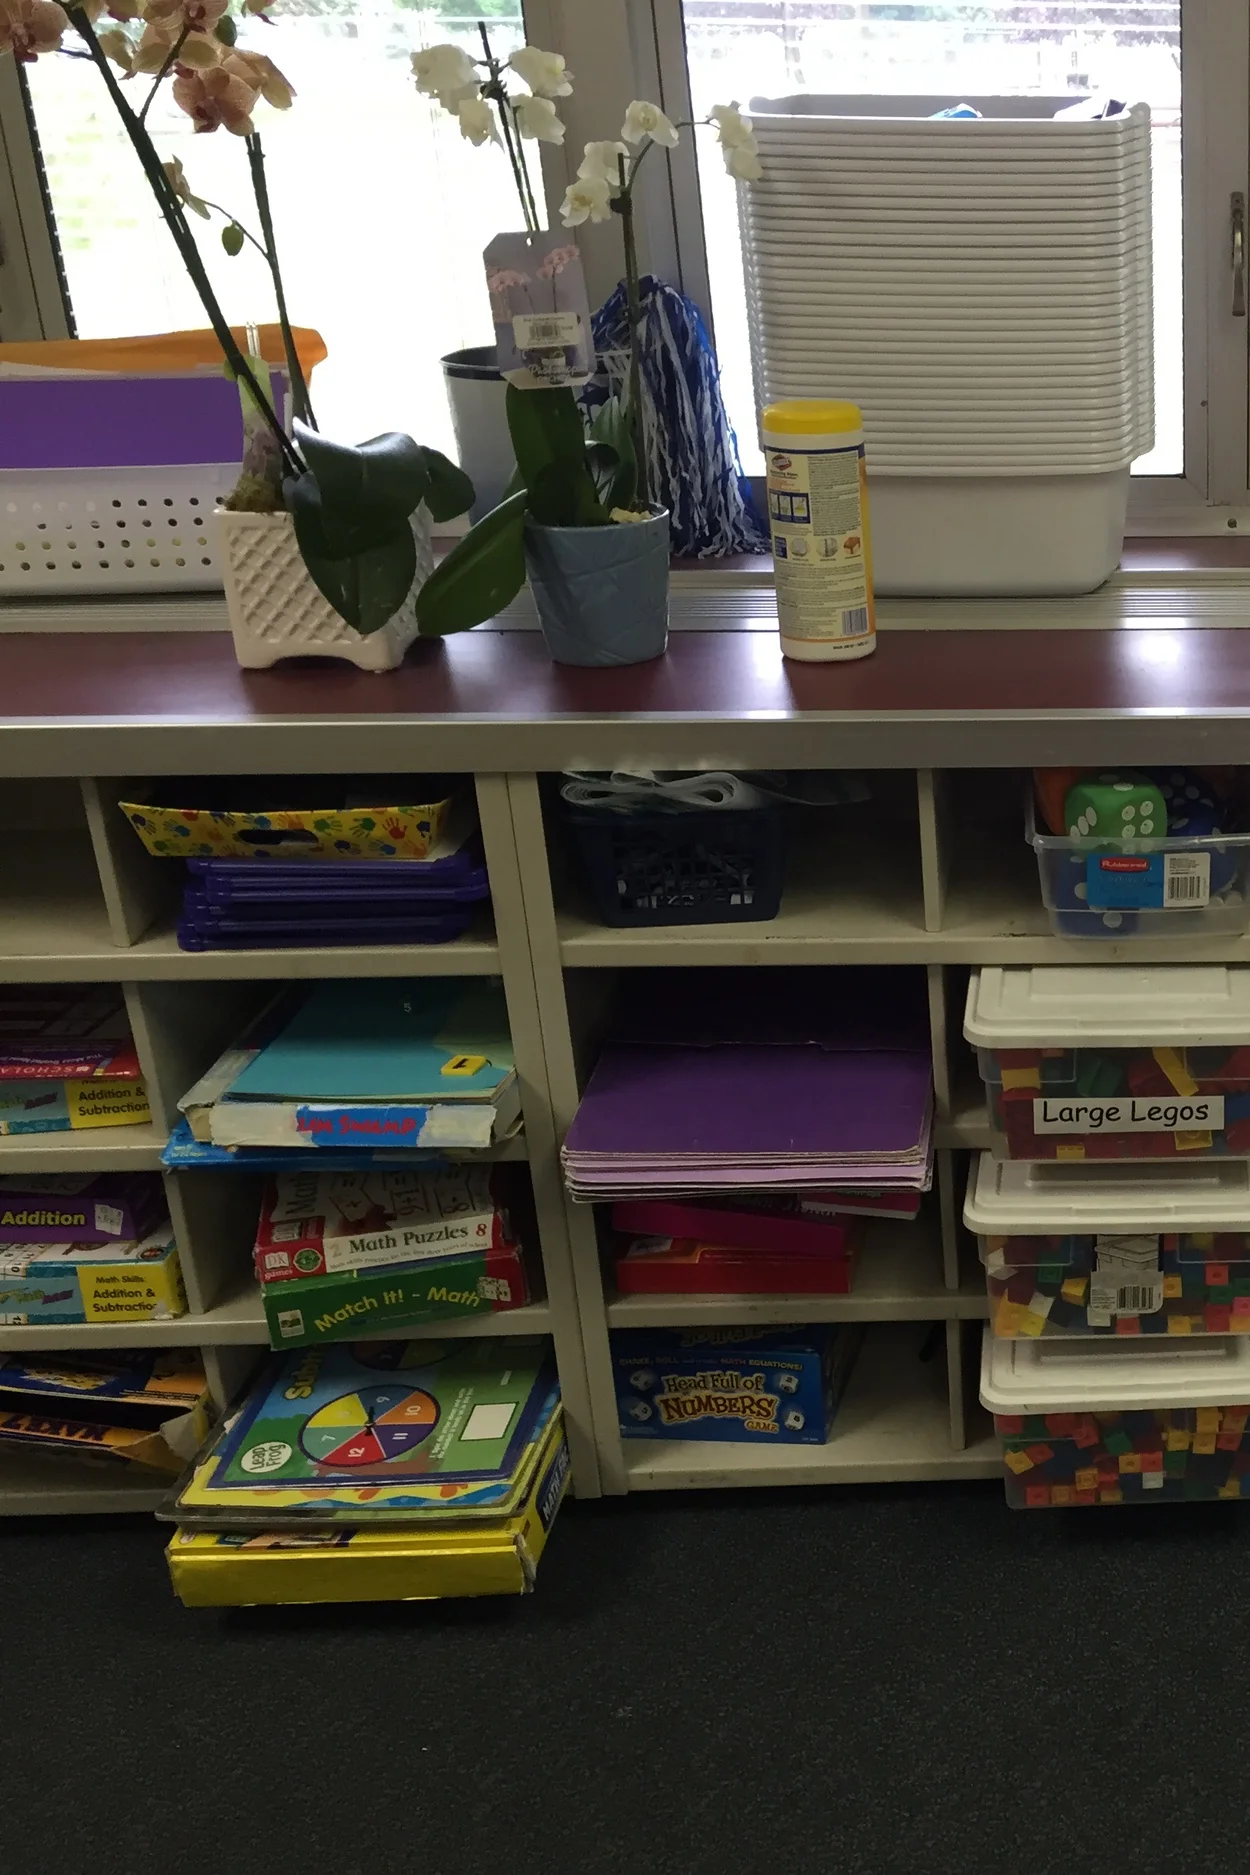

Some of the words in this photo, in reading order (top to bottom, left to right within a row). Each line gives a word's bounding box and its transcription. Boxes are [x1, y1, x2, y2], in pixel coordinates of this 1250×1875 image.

[79, 1087, 131, 1102] Addition
[136, 1086, 146, 1097] &
[79, 1102, 150, 1116] Subtraction
[1043, 1101, 1121, 1127] Large
[1131, 1100, 1209, 1127] Legos
[1, 1210, 86, 1227] Addition
[348, 1234, 398, 1255] Math
[403, 1225, 469, 1247] Puzzles
[475, 1223, 487, 1237] 8
[96, 1276, 120, 1284] Math
[93, 1288, 143, 1300] Addition
[145, 1288, 156, 1298] &
[93, 1302, 158, 1313] Subtractio
[313, 1293, 378, 1333] Match
[382, 1288, 404, 1306] It!
[426, 1285, 481, 1308] Math
[720, 1357, 746, 1365] MATH
[748, 1358, 804, 1371] EQUATIONS!
[665, 1373, 706, 1392] Head
[710, 1371, 740, 1390] Full
[743, 1374, 764, 1392] of
[404, 1404, 422, 1416] 10
[660, 1393, 775, 1421] NUMBERS
[746, 1420, 779, 1432] GAME
[391, 1431, 409, 1441] 11
[251, 1443, 266, 1471] Leap
[266, 1441, 286, 1471] Frog
[348, 1445, 365, 1459] 12
